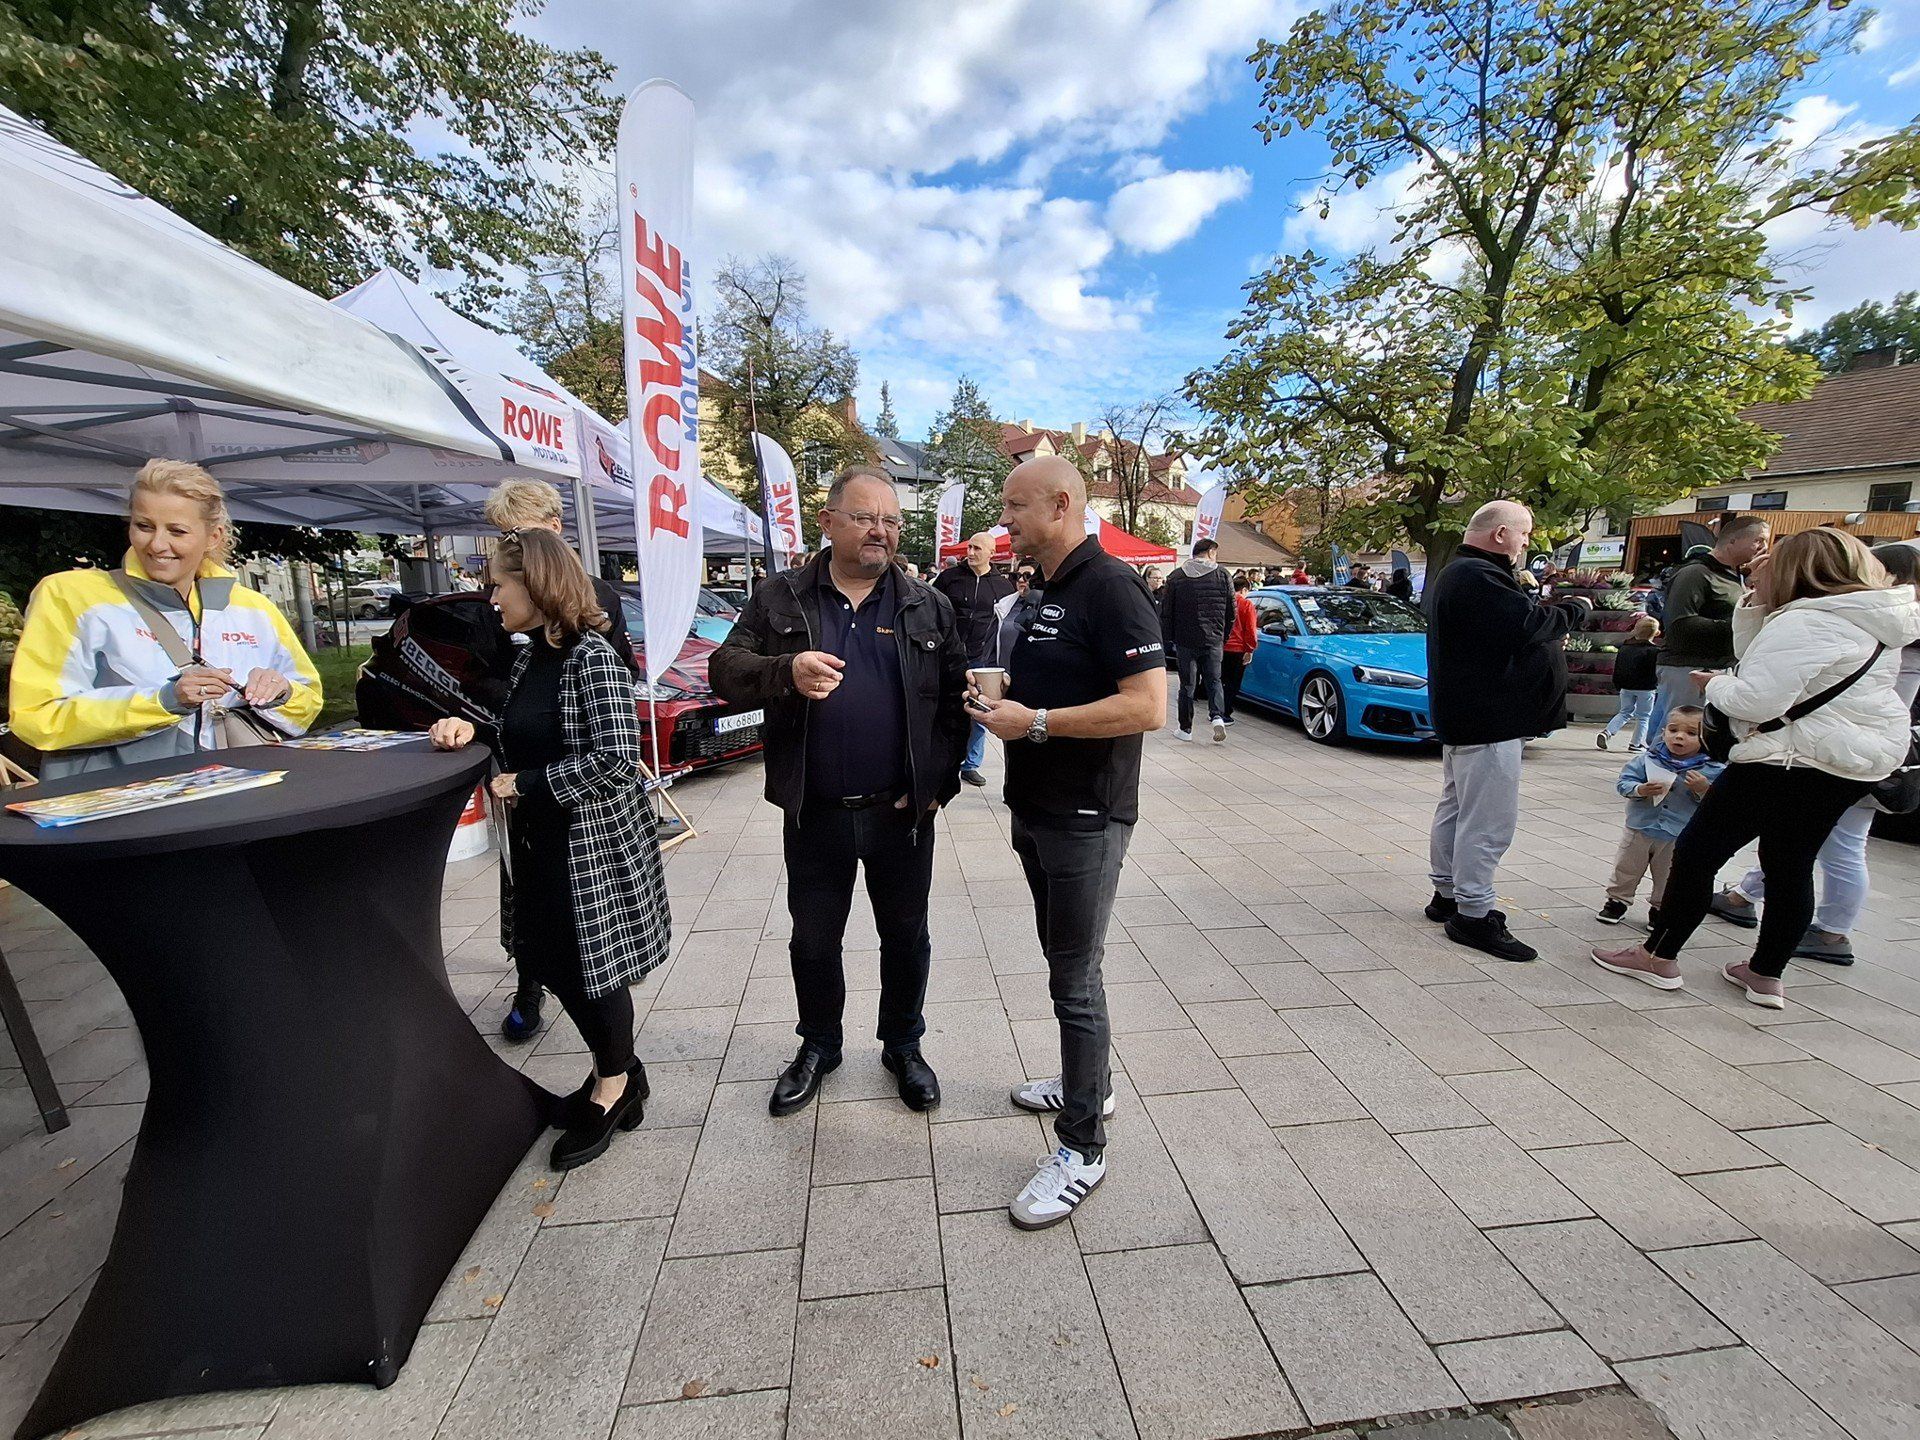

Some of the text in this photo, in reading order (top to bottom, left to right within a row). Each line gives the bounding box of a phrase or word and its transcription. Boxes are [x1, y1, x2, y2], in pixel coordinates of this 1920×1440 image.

[634, 208, 690, 540] ROWE
[500, 396, 564, 450] ROWE
[222, 632, 257, 645] ROWE
[399, 655, 450, 698] AUTOMOTIVE
[721, 711, 761, 731] KK 68801
